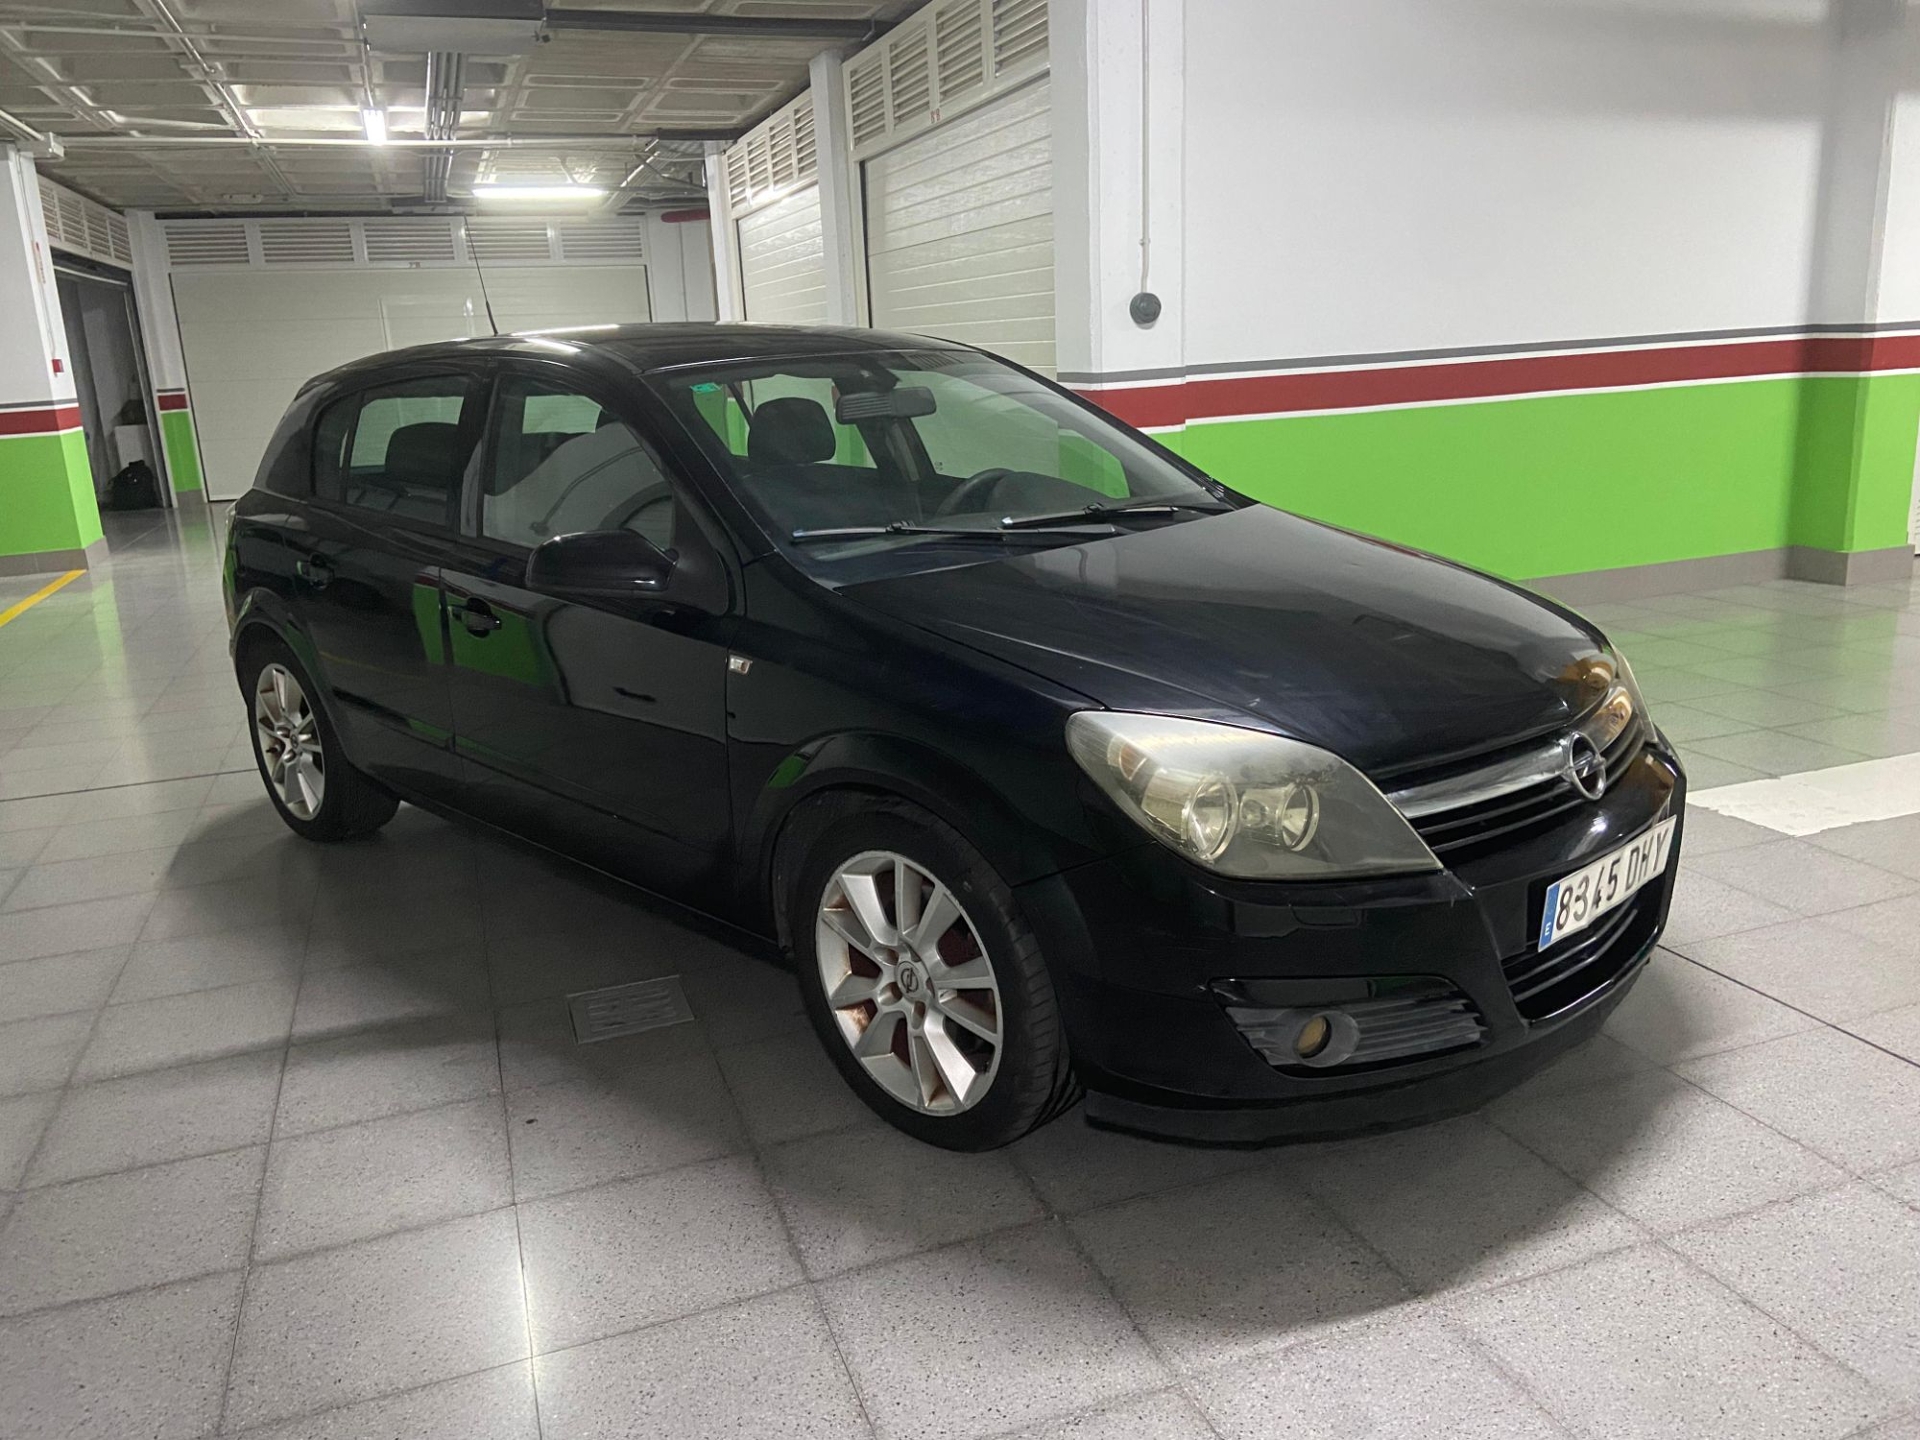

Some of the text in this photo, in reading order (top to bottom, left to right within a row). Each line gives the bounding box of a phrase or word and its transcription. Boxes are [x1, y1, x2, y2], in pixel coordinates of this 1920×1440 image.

[1544, 827, 1669, 936] E 8345 DHY
